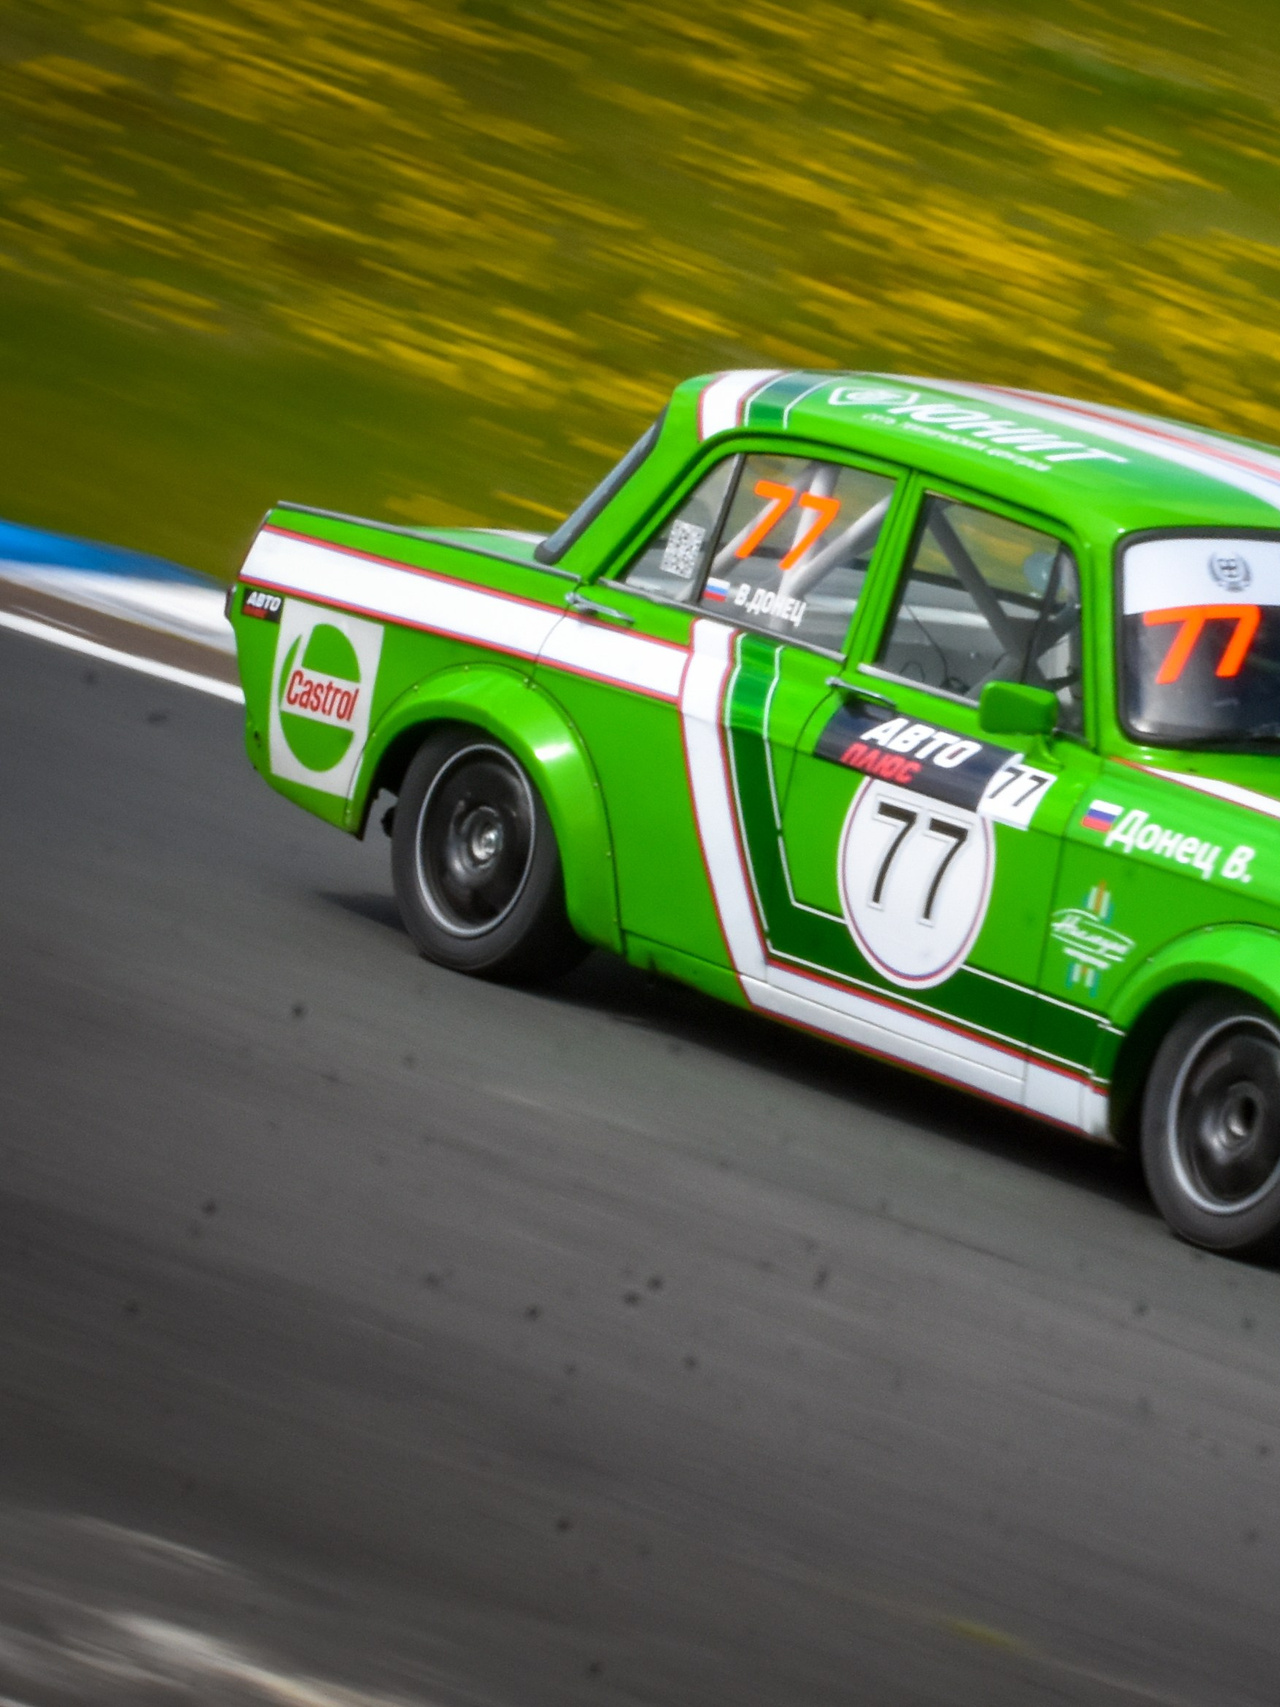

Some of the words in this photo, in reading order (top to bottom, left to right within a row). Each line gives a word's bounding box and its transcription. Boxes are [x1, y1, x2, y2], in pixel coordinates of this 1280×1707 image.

[888, 403, 1128, 464] ЮНИТ
[735, 480, 841, 570] 77
[246, 591, 282, 612] АВТО
[1143, 603, 1262, 685] 77
[286, 669, 360, 722] Castrol
[840, 742, 923, 784] ПЛЮС
[860, 717, 983, 769] АВТО
[988, 765, 1049, 808] 77
[871, 799, 970, 921] 77
[1104, 808, 1222, 880] Донец
[1221, 844, 1257, 883] В.
